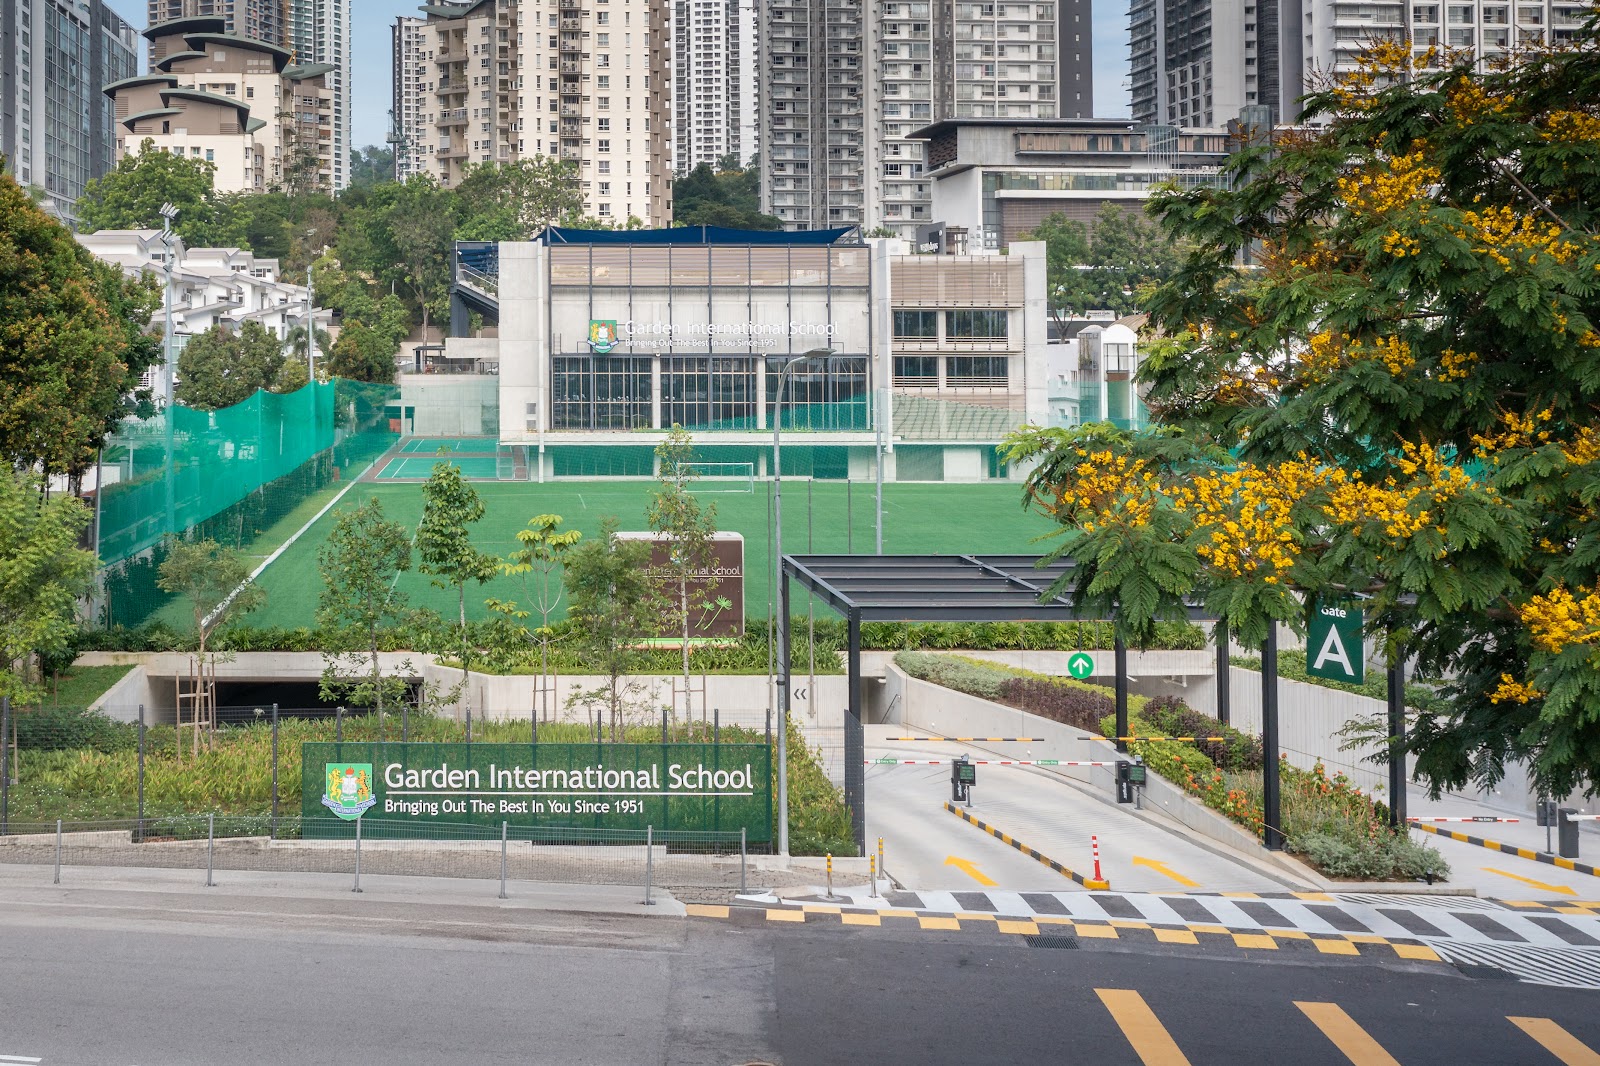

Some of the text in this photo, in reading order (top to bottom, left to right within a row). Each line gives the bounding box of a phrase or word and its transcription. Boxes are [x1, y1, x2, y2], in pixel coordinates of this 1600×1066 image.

[625, 320, 839, 335] Garden International School
[625, 339, 656, 348] Bringing
[659, 339, 673, 347] Out
[675, 339, 690, 347] The
[693, 339, 708, 347] Best
[711, 339, 719, 347] In
[721, 339, 736, 347] You
[737, 339, 758, 347] Since
[760, 339, 777, 347] 1951
[711, 566, 740, 575] School
[1313, 623, 1355, 676] A
[384, 763, 754, 789] Garden International School
[385, 799, 439, 815] Bringing
[442, 799, 467, 813] Out
[470, 799, 496, 813] The
[499, 799, 528, 813] Best
[532, 799, 544, 813] In
[548, 799, 571, 813] You
[574, 799, 610, 813] Since
[614, 799, 644, 813] 1951
